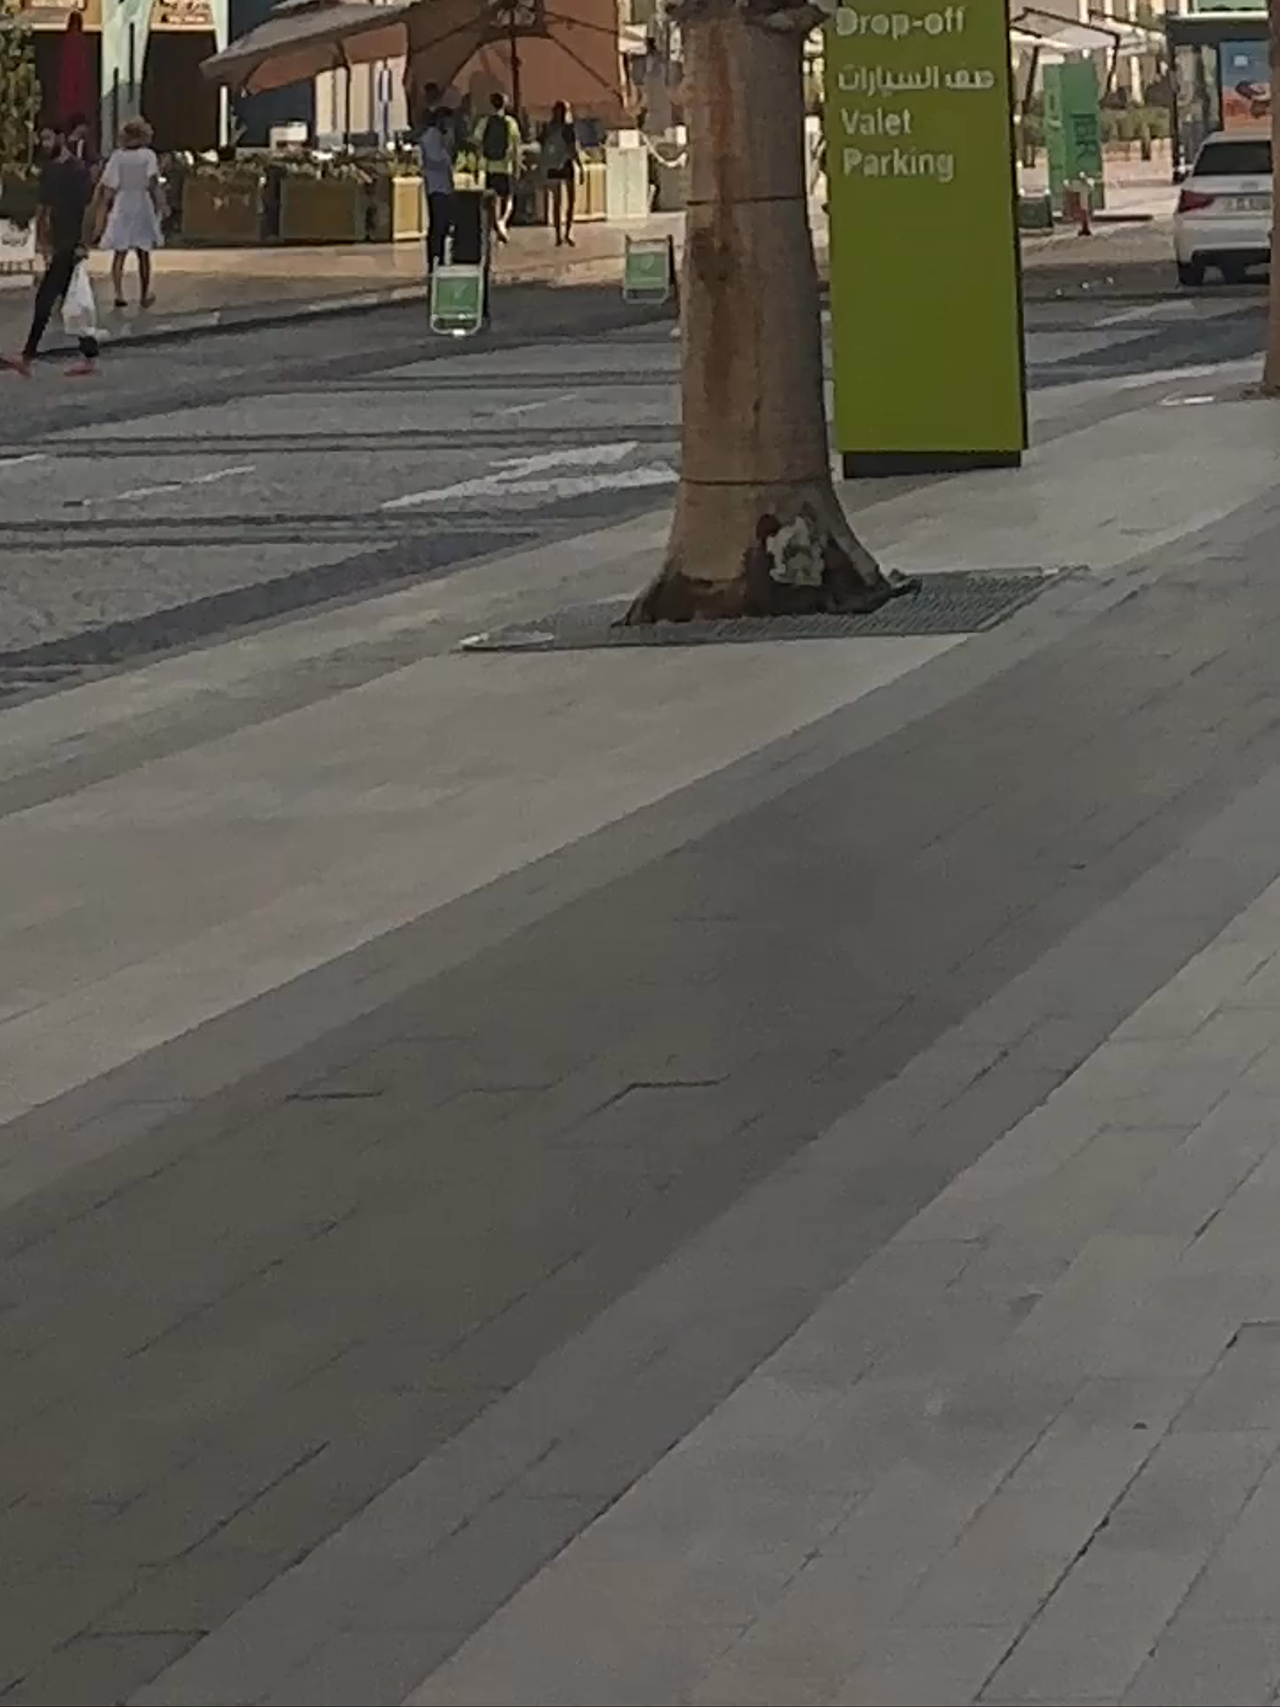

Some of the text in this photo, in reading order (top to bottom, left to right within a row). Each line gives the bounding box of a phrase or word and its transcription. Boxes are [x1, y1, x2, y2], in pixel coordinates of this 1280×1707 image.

[836, 5, 967, 41] Drop-off
[837, 60, 996, 98] صف السيارات
[840, 107, 912, 136] Valet
[841, 145, 955, 184] Parking
